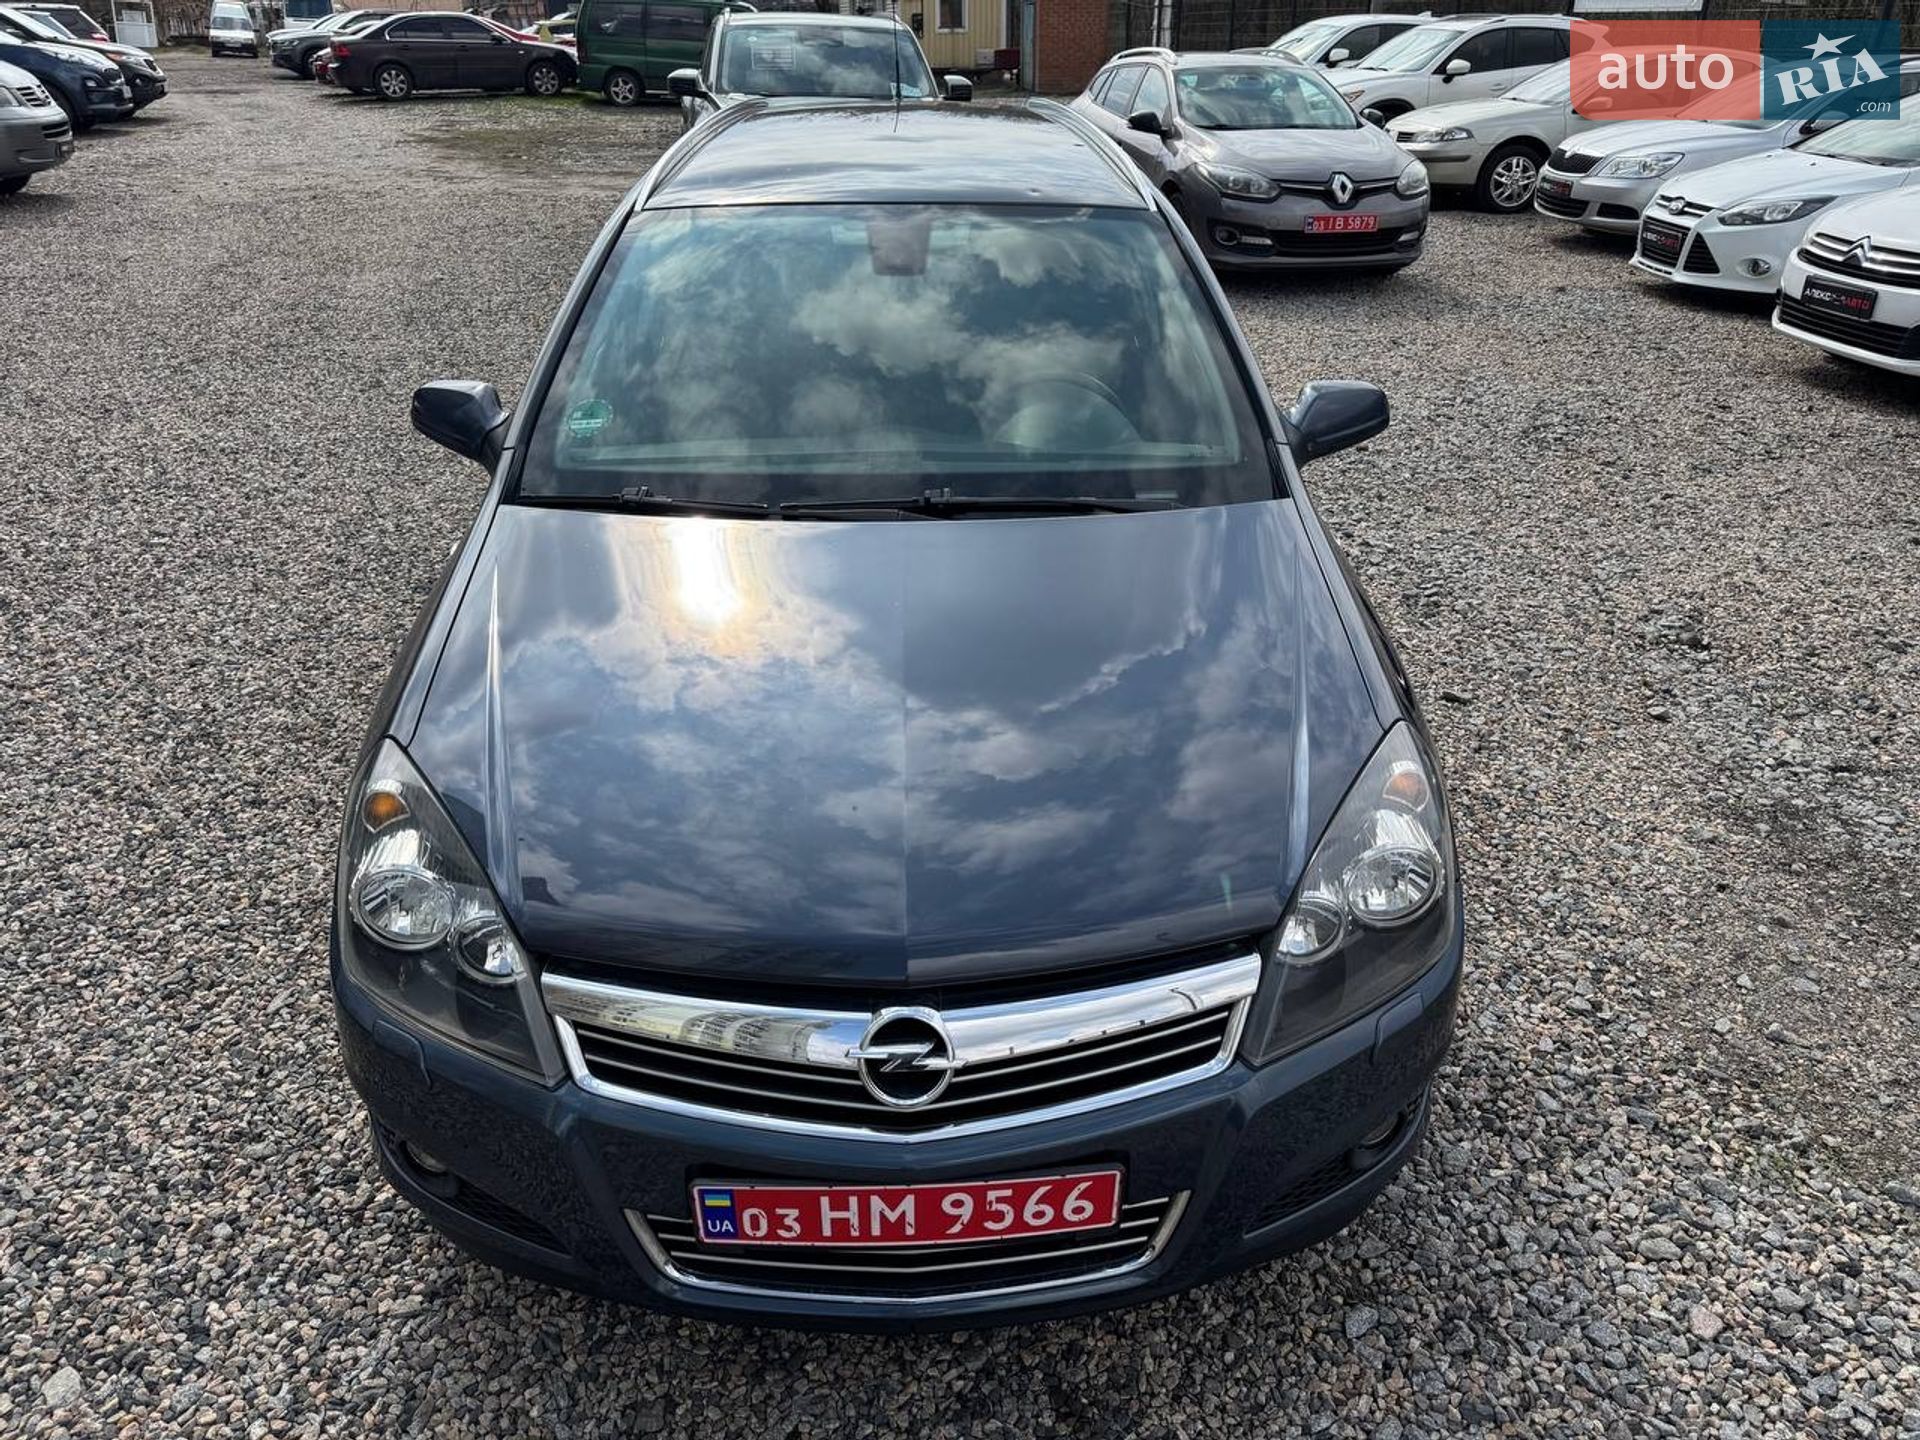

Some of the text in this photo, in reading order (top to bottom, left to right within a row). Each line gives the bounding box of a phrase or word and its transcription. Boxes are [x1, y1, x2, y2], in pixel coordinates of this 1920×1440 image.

[706, 1219, 735, 1233] UA
[741, 1181, 1096, 1238] 03 HM 9566
